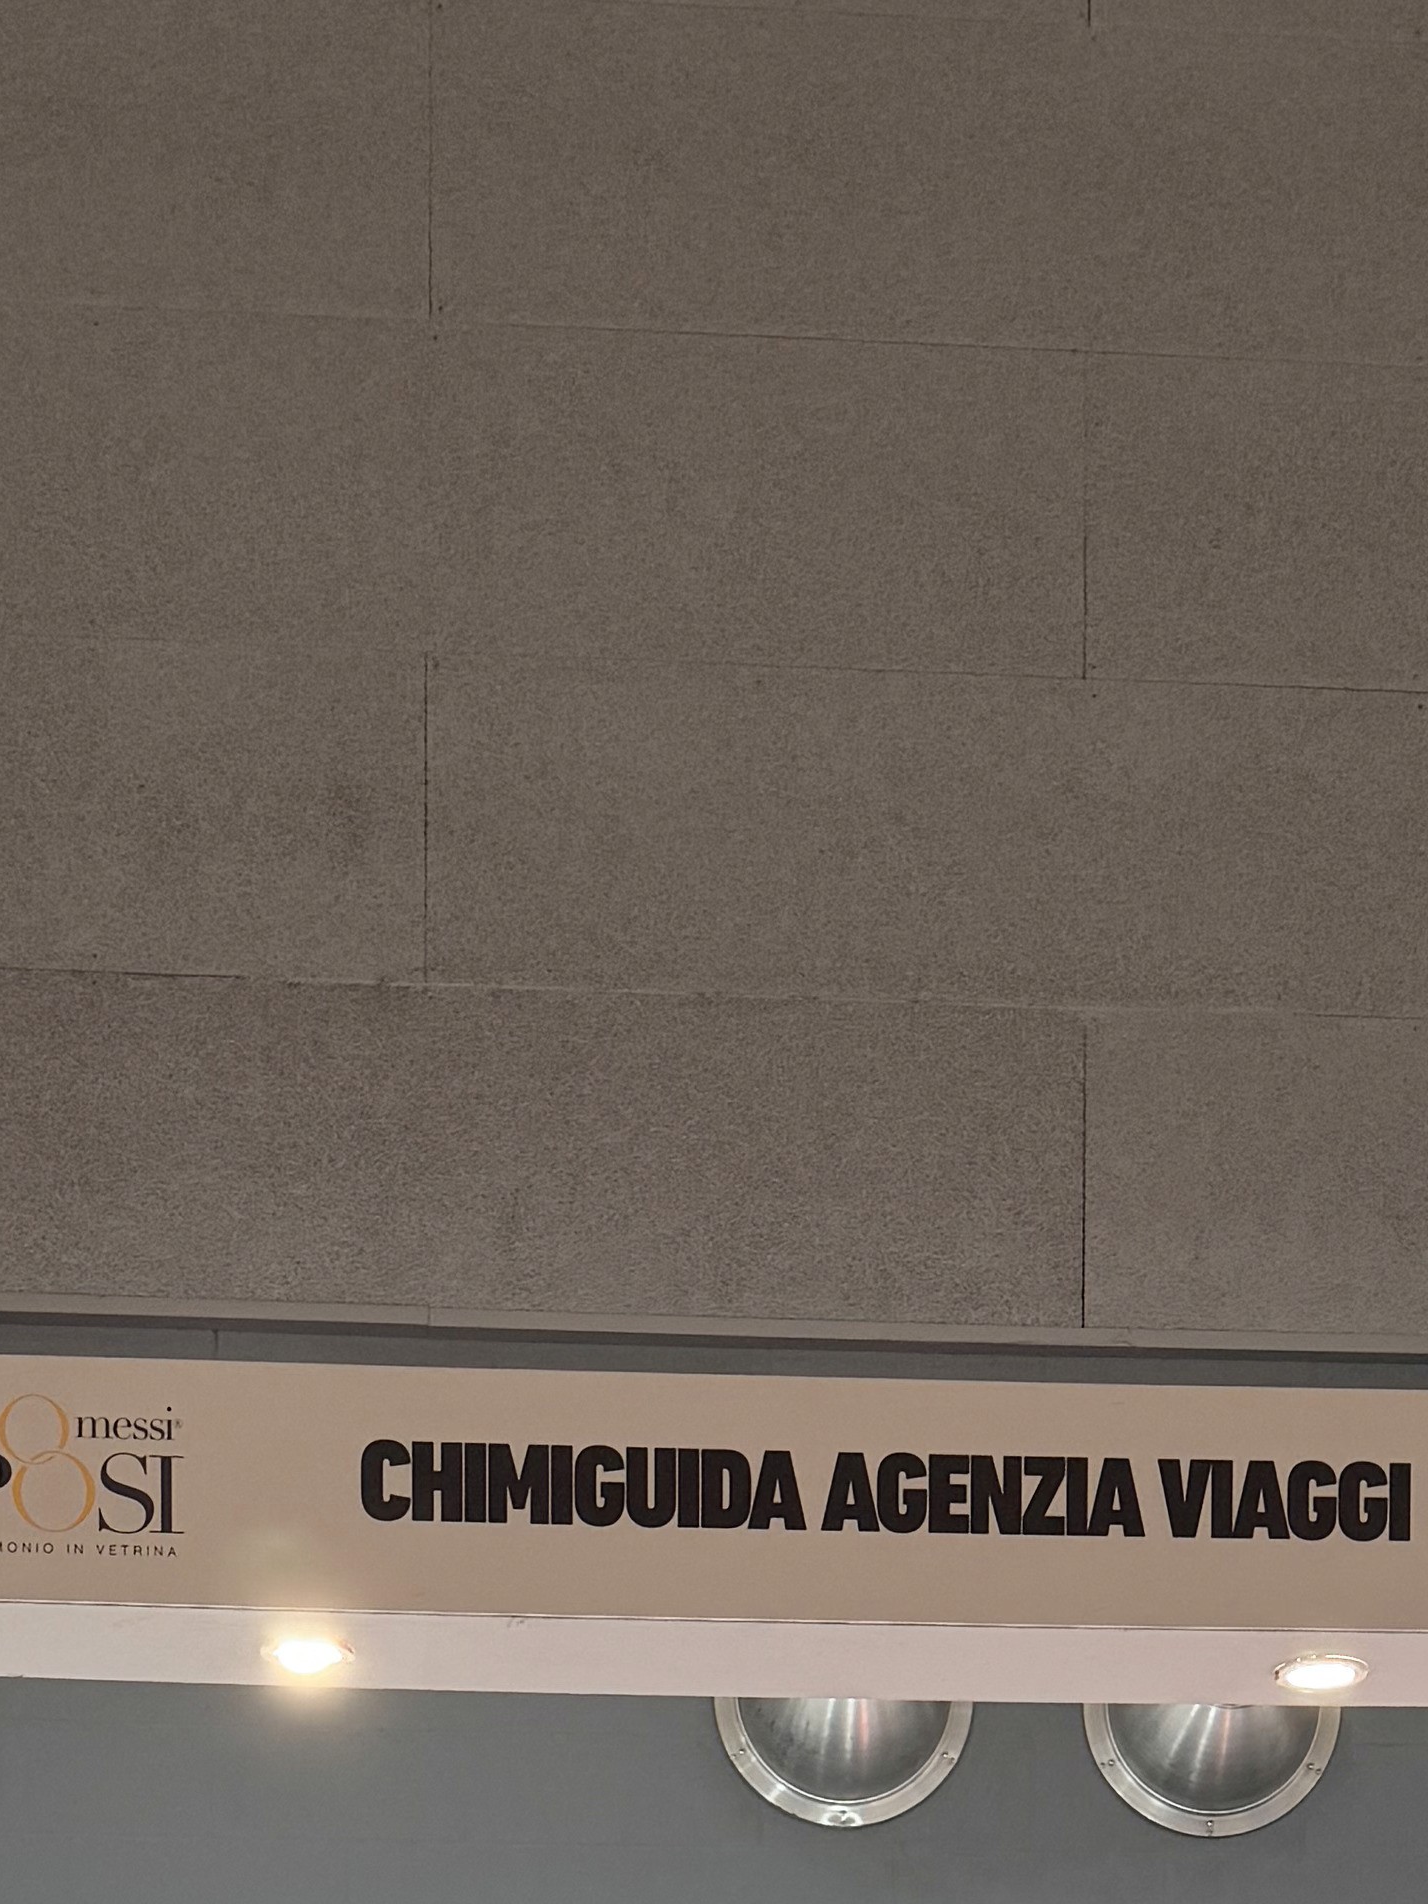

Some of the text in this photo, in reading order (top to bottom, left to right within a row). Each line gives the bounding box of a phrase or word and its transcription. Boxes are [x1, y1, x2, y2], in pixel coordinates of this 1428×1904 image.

[361, 1439, 1411, 1541] CHIMIGUIDA AGENZIA VIAGGI
[66, 1543, 84, 1555] IN
[96, 1545, 177, 1557] VETRINA
